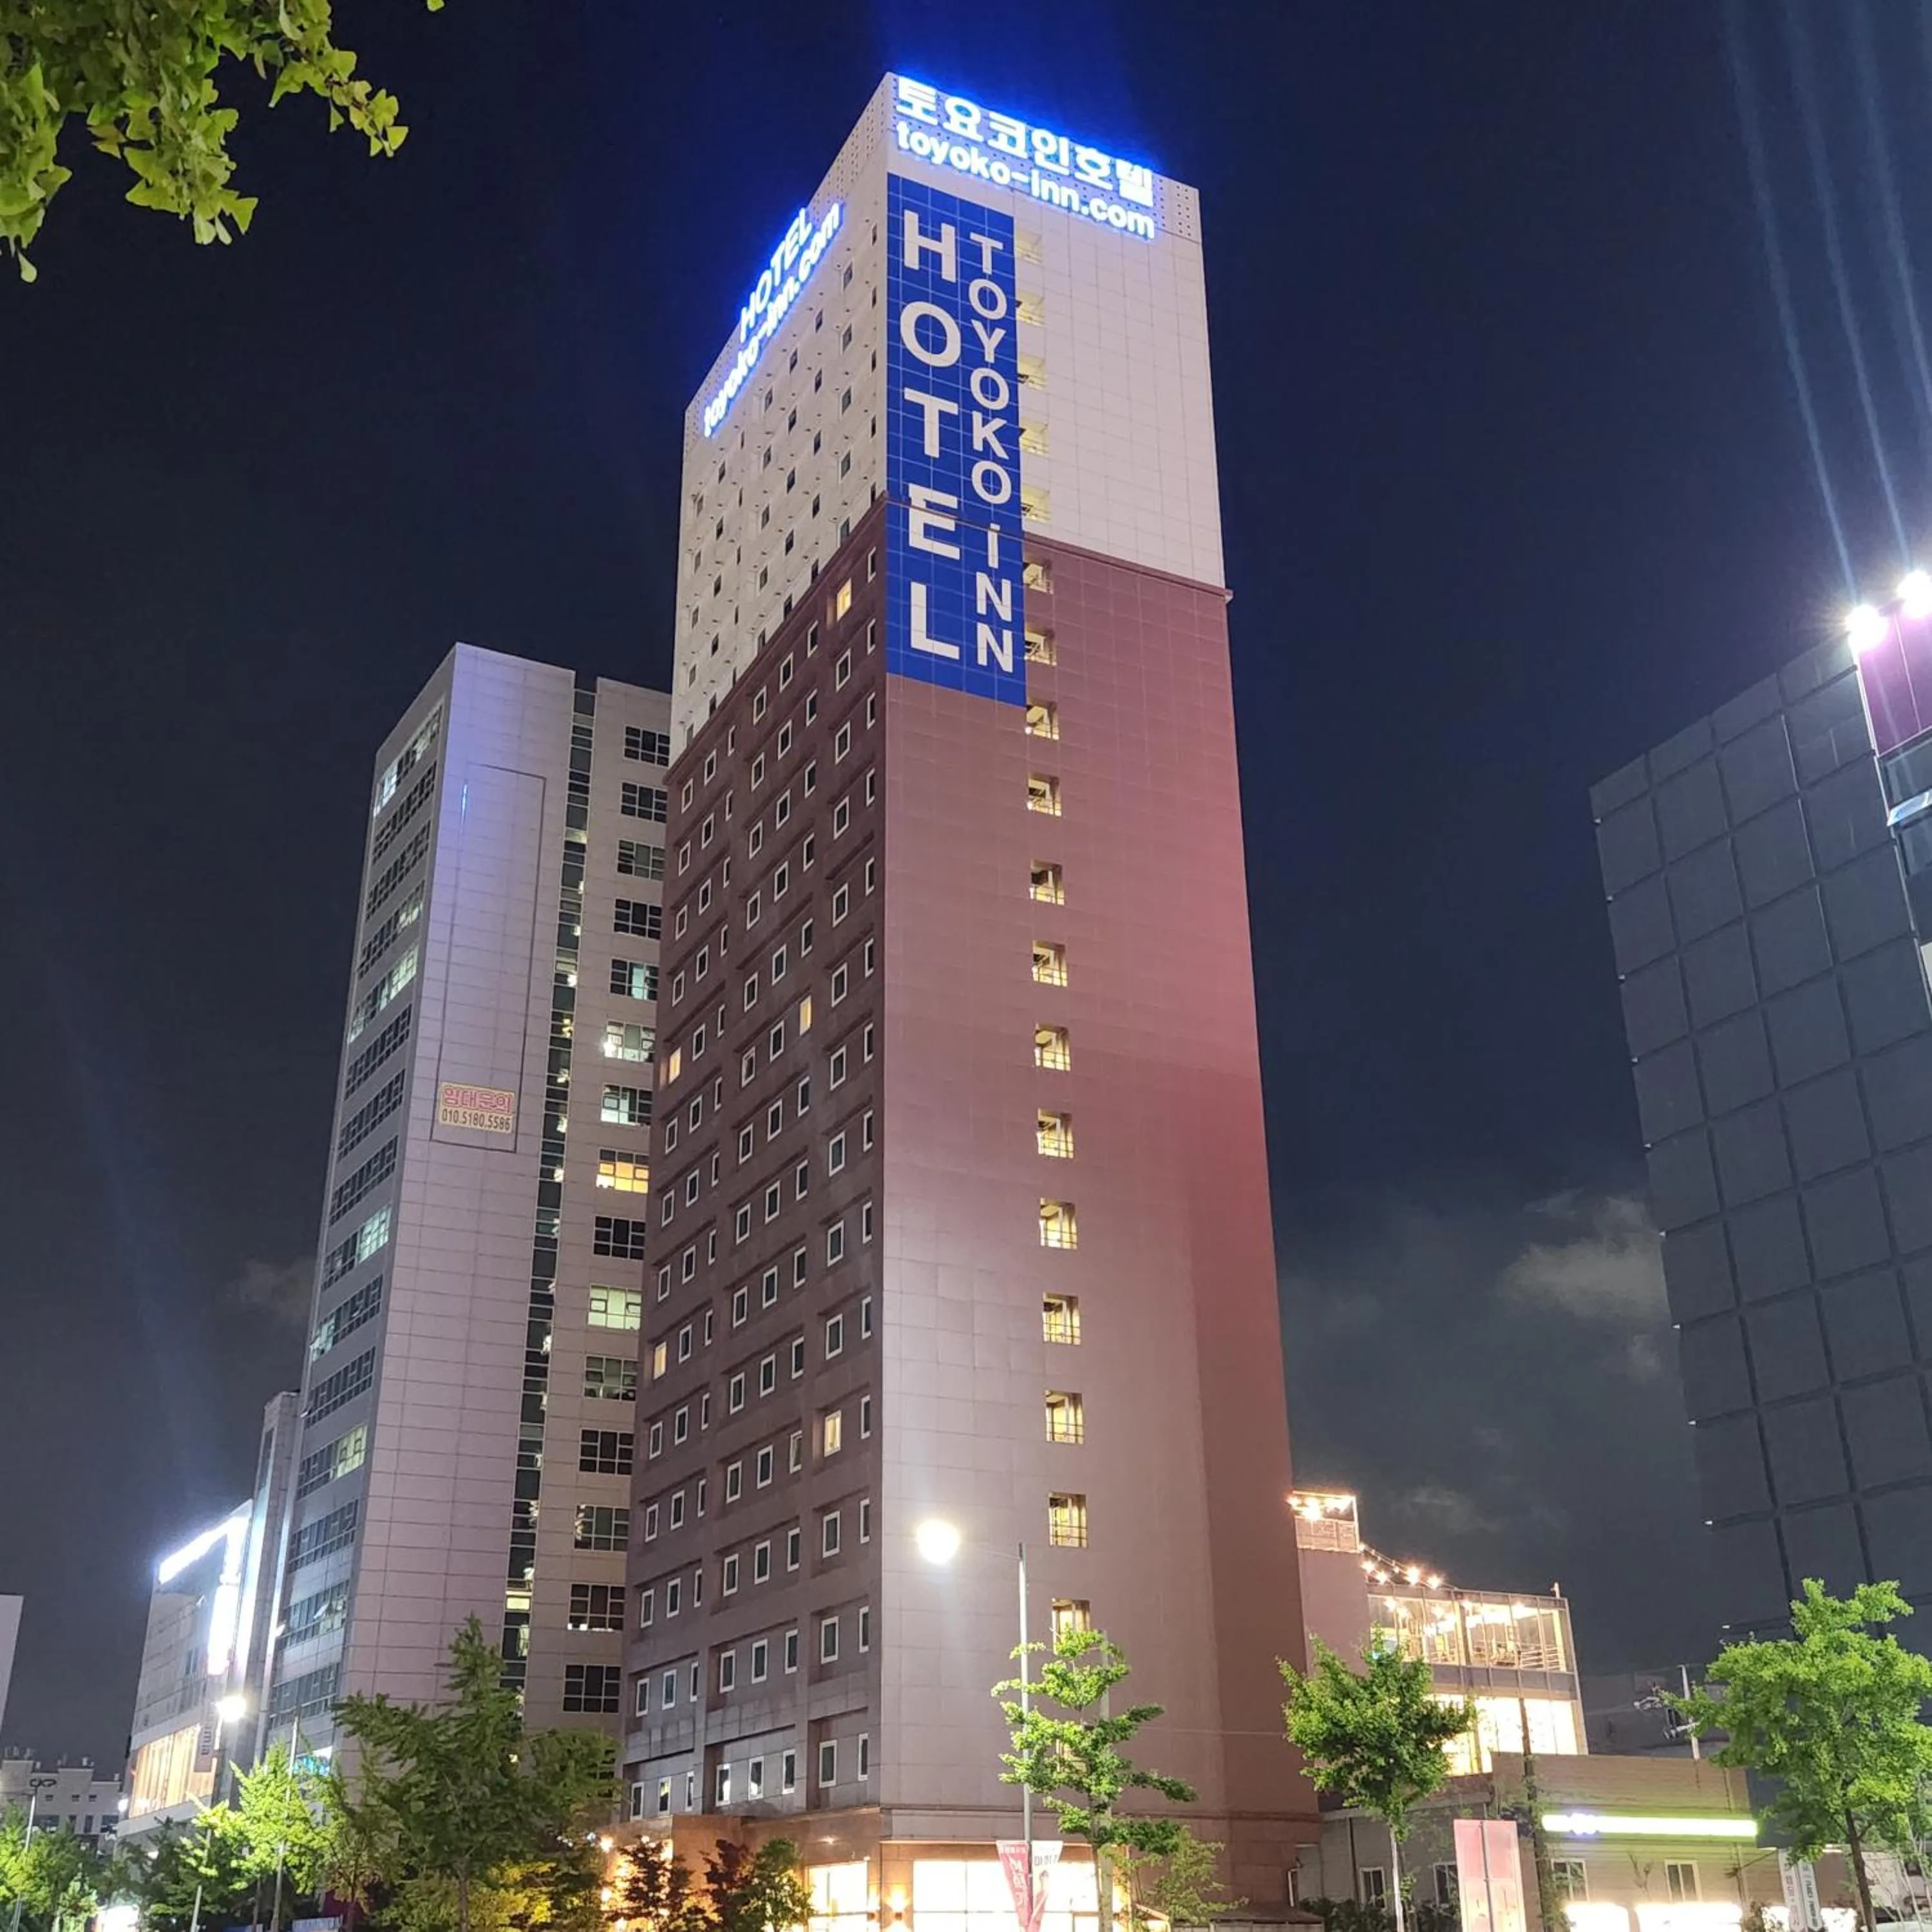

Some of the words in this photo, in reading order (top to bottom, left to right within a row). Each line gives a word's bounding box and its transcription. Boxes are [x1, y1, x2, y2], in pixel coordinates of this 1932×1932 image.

[896, 122, 1155, 239] toyoko-inn.com
[739, 207, 812, 343] HOTEL
[900, 209, 961, 660] HOTEL
[969, 232, 1012, 504] TOYOKO
[444, 1088, 511, 1113] 임대문의
